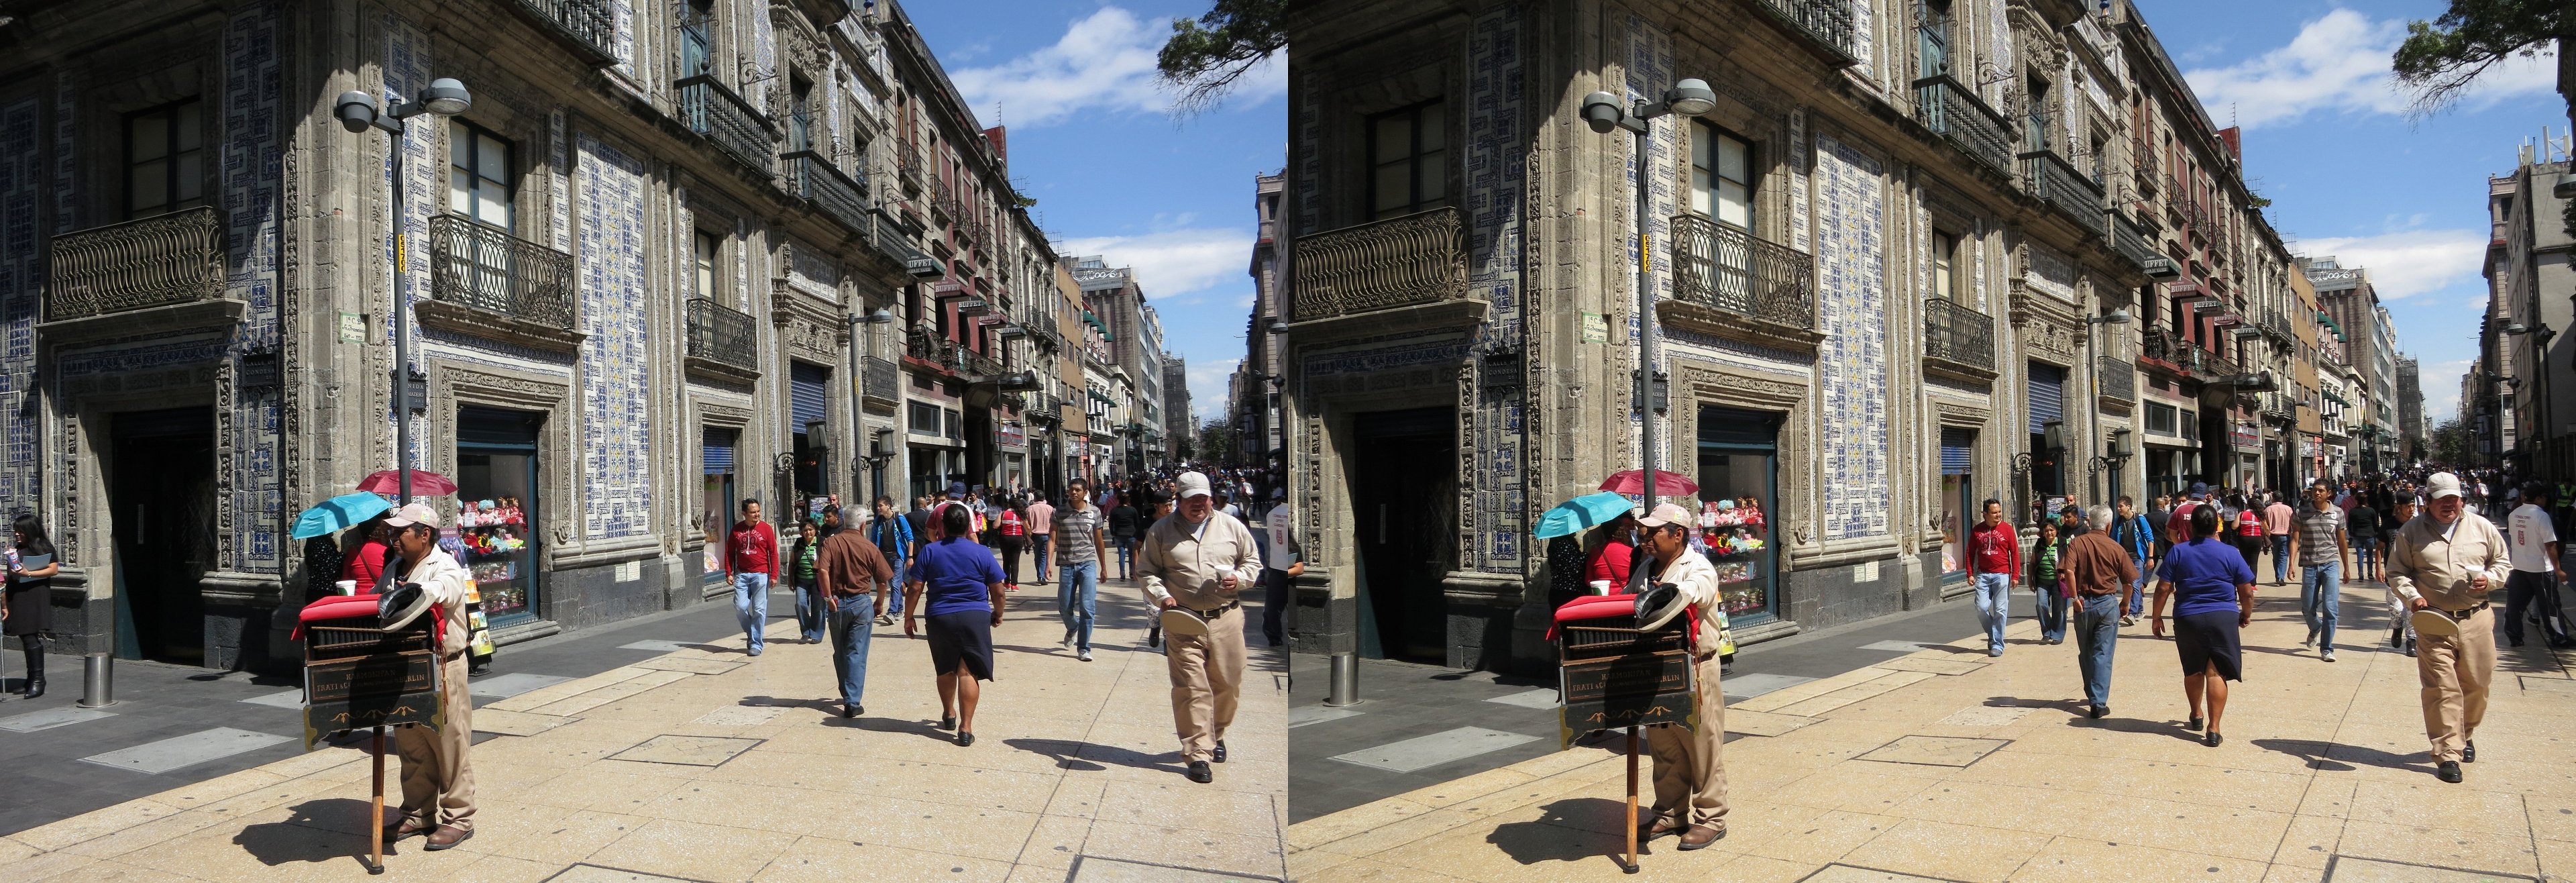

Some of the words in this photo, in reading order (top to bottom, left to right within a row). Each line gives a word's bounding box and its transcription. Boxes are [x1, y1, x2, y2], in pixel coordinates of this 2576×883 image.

[908, 259, 932, 268] UFFET
[935, 284, 960, 293] BUFFET
[2171, 284, 2196, 293] BUFFET
[751, 529, 764, 541] IPSUM
[1992, 529, 2006, 541] IPSUM
[345, 670, 396, 680] HARMONIPAN
[398, 674, 425, 683] BERLIN
[1601, 670, 1651, 680] HARMONIPAN
[1654, 674, 1680, 683] BERLIN
[317, 683, 338, 692] FRATI
[1572, 683, 1594, 692] FRATI
